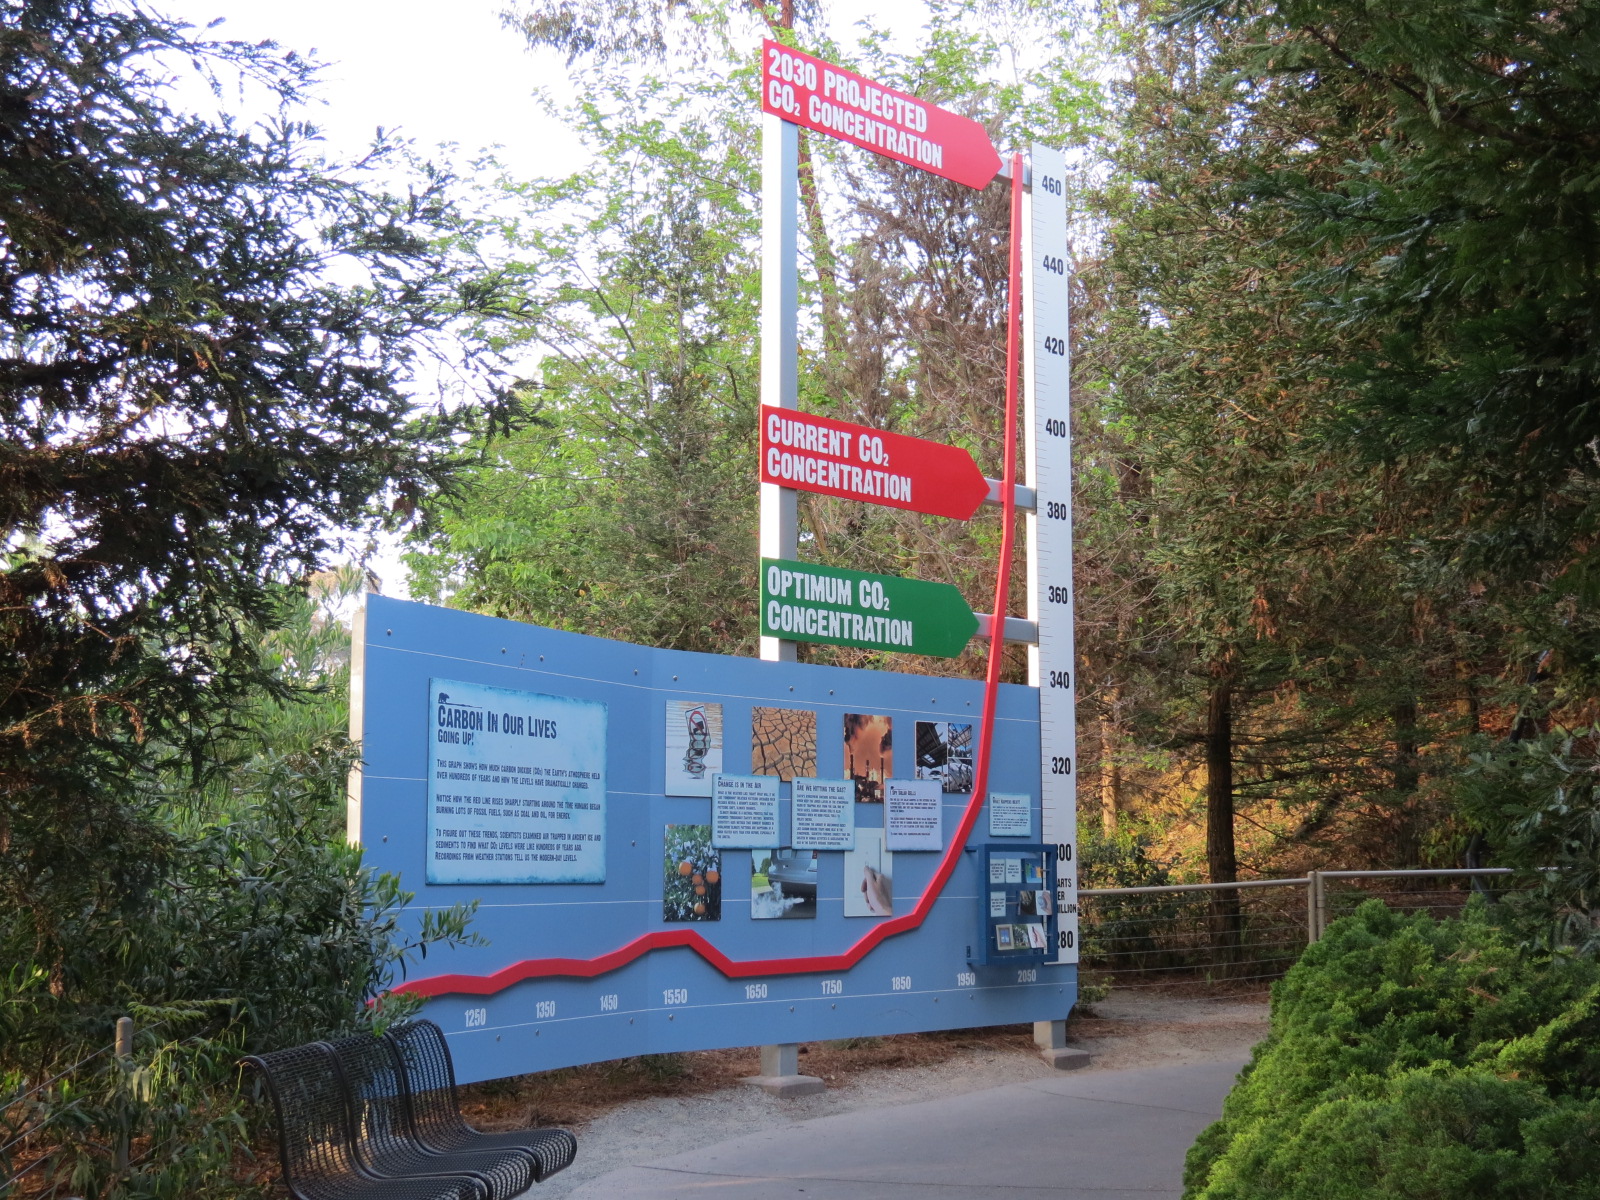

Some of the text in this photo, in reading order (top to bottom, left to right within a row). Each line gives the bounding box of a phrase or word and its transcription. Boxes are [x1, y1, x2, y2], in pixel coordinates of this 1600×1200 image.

[769, 49, 927, 134] 2030 PROJECTED
[809, 95, 943, 169] CONCENTRATION
[1042, 175, 1062, 196] 460
[1043, 254, 1064, 276] 440
[1044, 335, 1065, 356] 420
[767, 414, 852, 459] CURRENT
[1045, 418, 1066, 438] 400
[767, 447, 912, 503] CONCENTRATION
[1047, 501, 1067, 521] 380
[767, 566, 852, 606] OPTIMUM
[1048, 585, 1068, 605] 360
[767, 600, 913, 647] CONCENTRATION
[1050, 671, 1070, 689] 340
[438, 705, 557, 739] CARBON IN OUR LIVES
[438, 729, 474, 746] GOING UP!
[437, 759, 447, 767] THIS
[1051, 756, 1071, 775] 320
[1056, 843, 1072, 861] 00
[1056, 878, 1072, 888] ARTS
[464, 969, 1037, 1028] 1250 1350 1450 1550 1650 1750 1850 1950 2050
